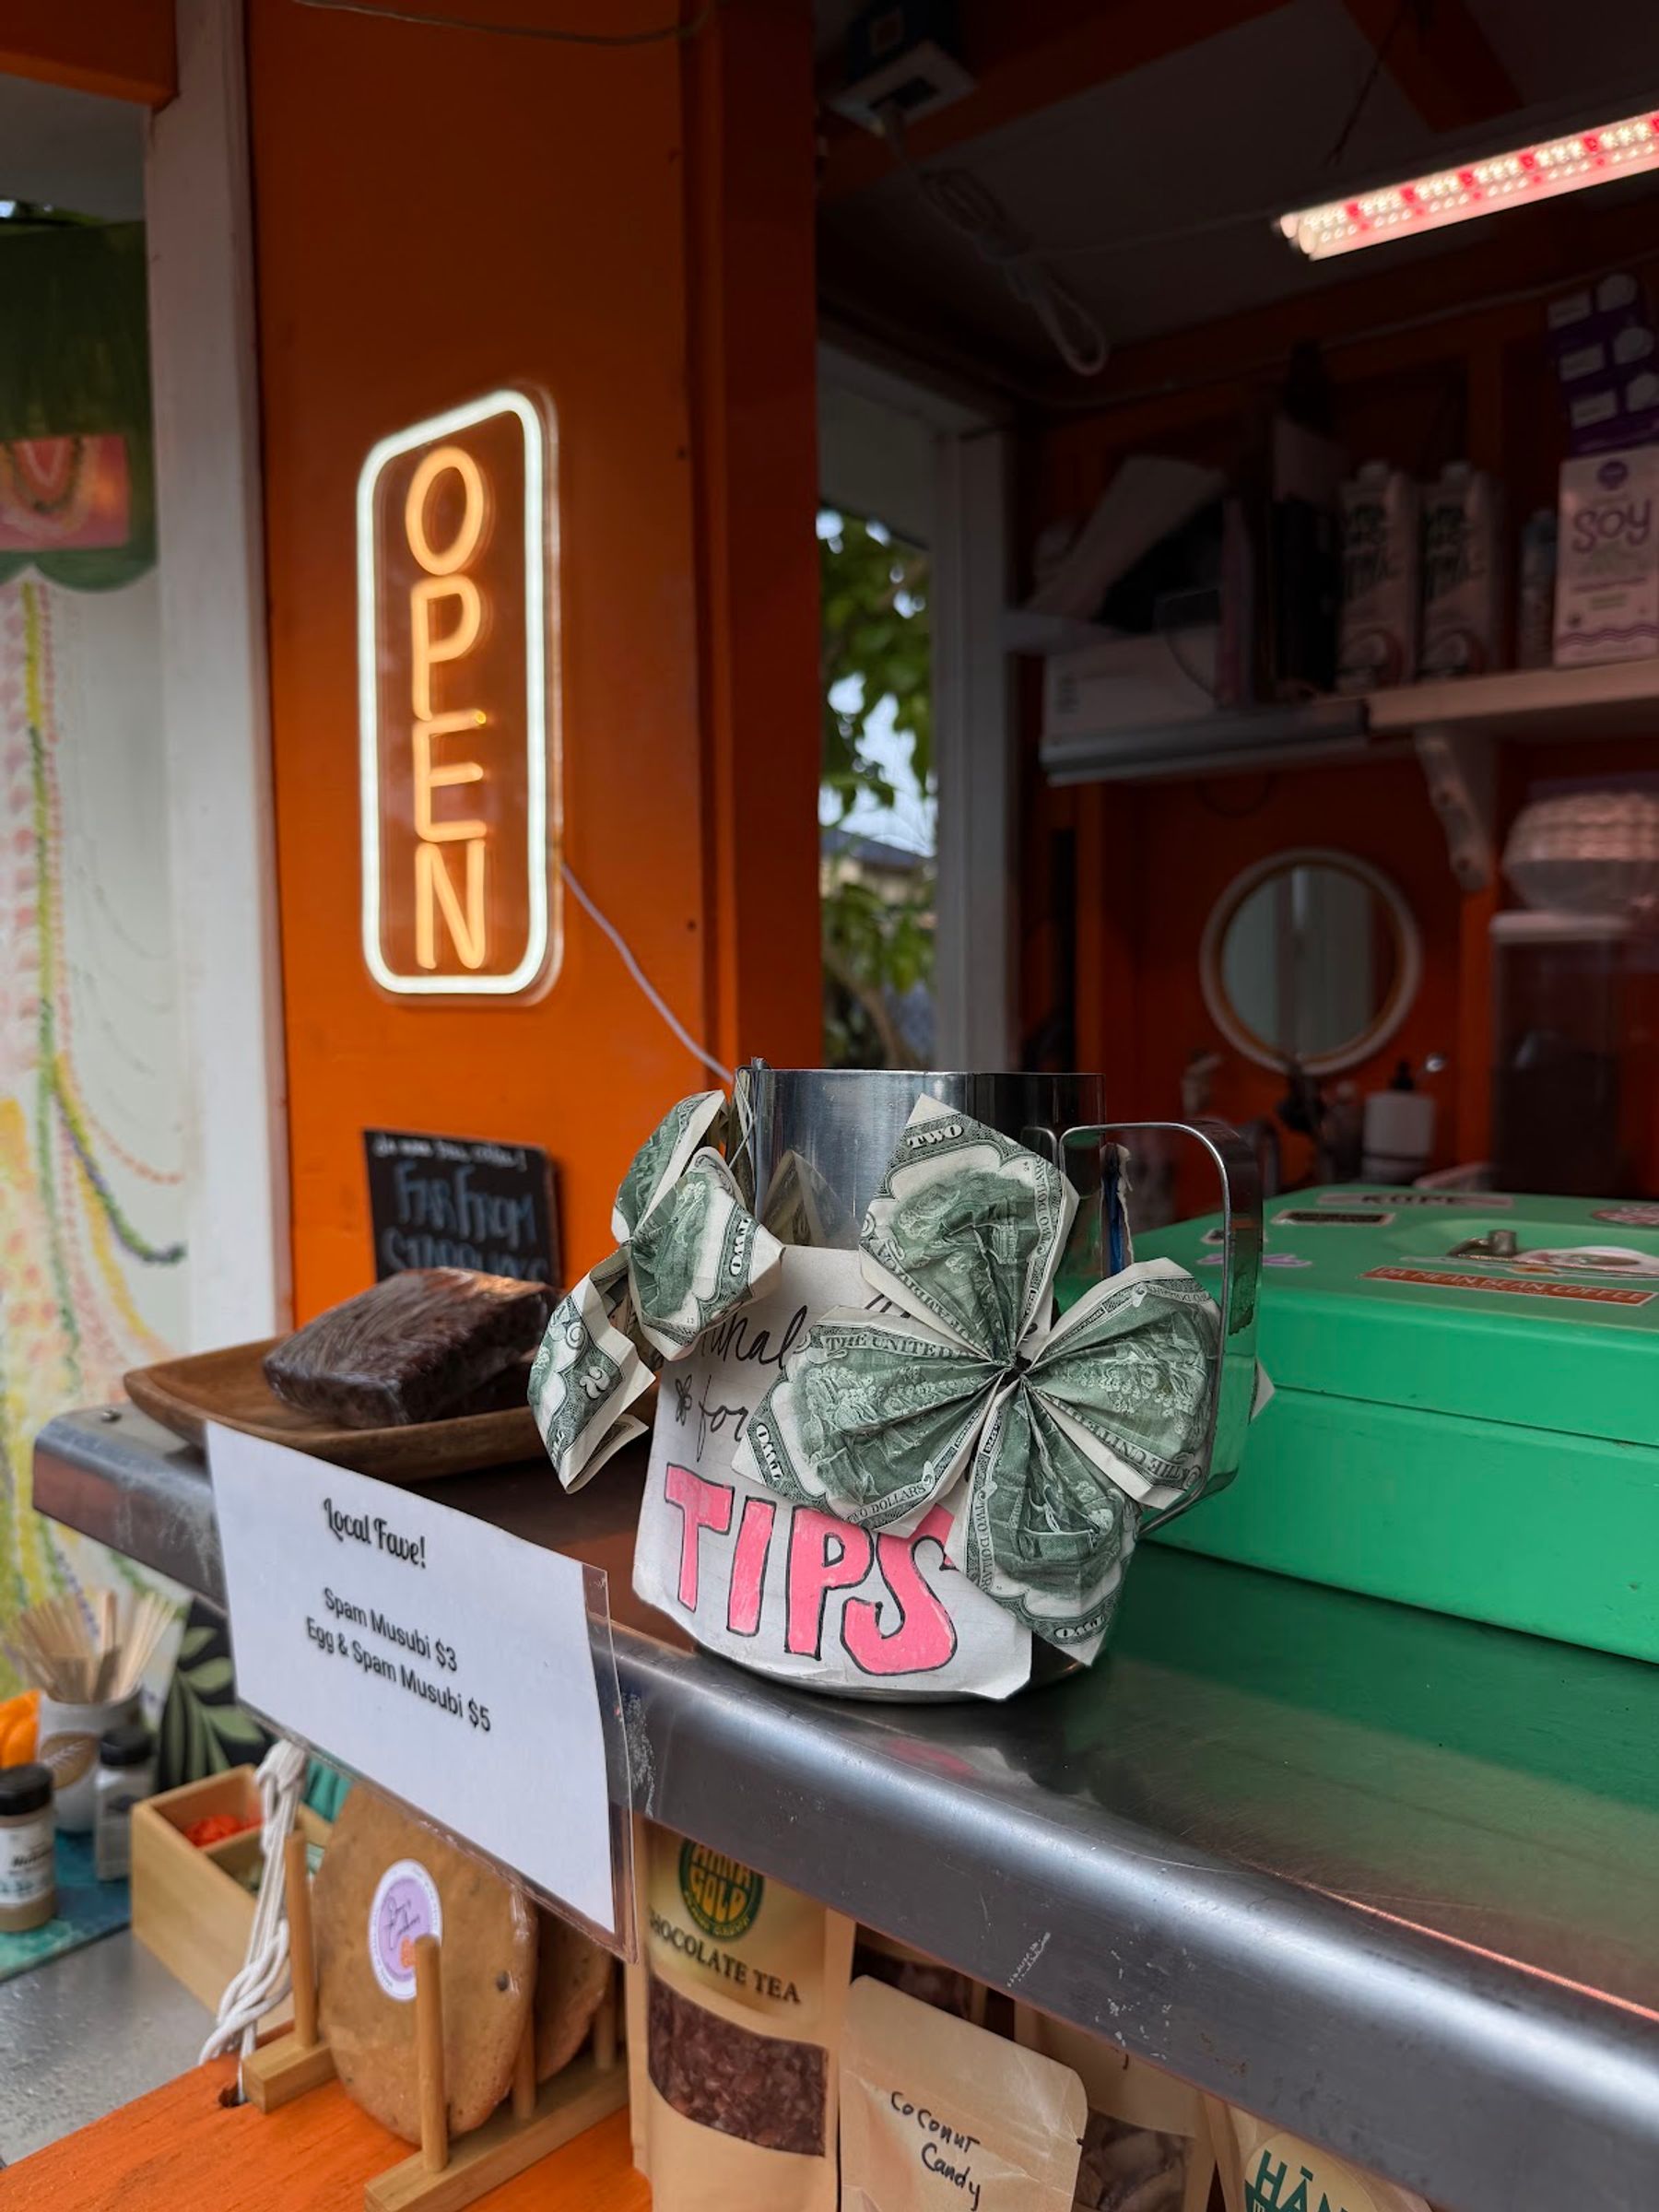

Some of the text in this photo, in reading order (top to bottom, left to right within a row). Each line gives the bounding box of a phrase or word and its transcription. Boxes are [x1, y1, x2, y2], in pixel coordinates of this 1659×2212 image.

[406, 446, 487, 971] OPEN
[906, 1123, 963, 1149] TWO
[827, 1333, 866, 1351] THE
[696, 1374, 748, 1463] for
[324, 1497, 426, 1569] Local Fave!
[872, 1484, 927, 1514] DOLLARS
[974, 1503, 988, 1537] TWO
[664, 1464, 958, 1676] TIPS
[324, 1586, 458, 1673] Spam Musubi $3
[306, 1616, 491, 1732] Egg & Spam Musubi $5
[689, 1865, 747, 1924] GOLD
[649, 1908, 747, 1985] HOCOLATE
[752, 1969, 801, 2004] TEA
[921, 2142, 981, 2211] Candy
